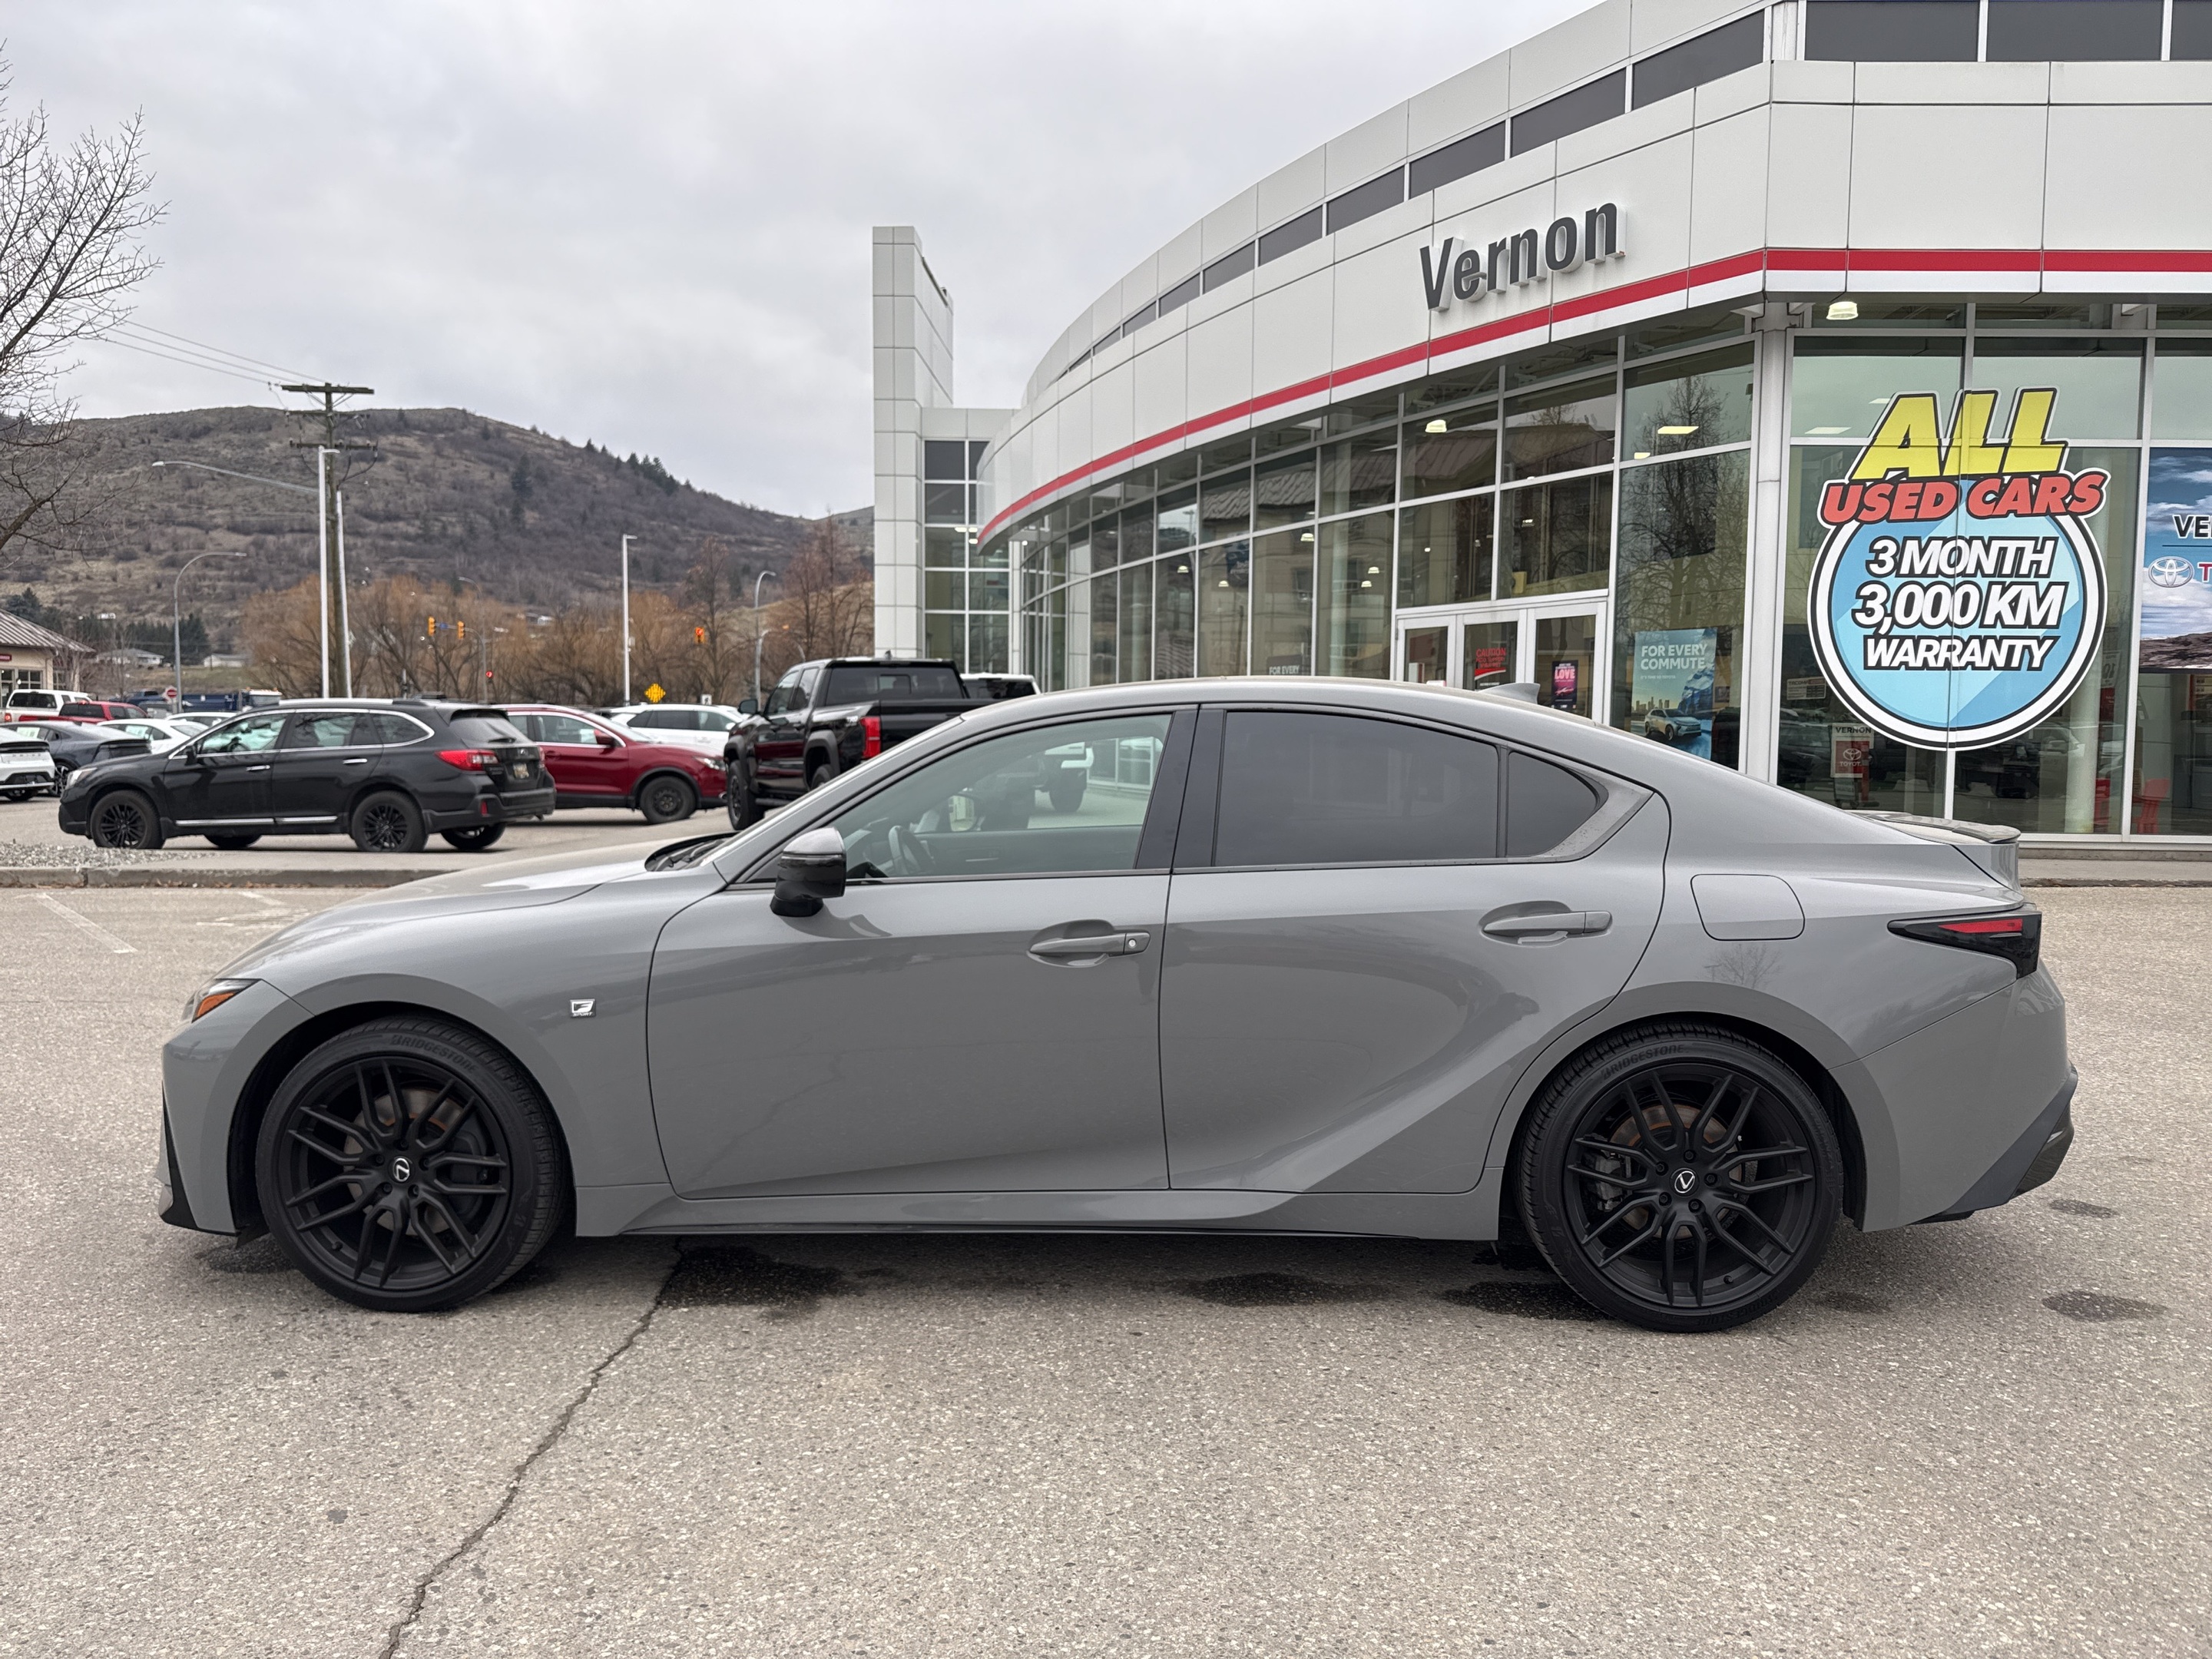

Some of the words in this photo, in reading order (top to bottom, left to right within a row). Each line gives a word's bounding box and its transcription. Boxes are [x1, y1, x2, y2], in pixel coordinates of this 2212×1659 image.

[1419, 203, 1622, 311] Vernon
[1850, 389, 2068, 480] ALL
[1823, 481, 1959, 523] USED
[1967, 473, 2107, 517] CARS
[2174, 515, 2212, 538] VE
[1869, 539, 1899, 575] 3
[1900, 539, 2055, 575] MONTH
[1856, 584, 1980, 635] 3,000
[1984, 585, 2065, 626] KM
[1641, 645, 1665, 657] FOR
[1667, 644, 1707, 656] EVERY
[1641, 657, 1705, 670] COMMUTE
[1866, 638, 2055, 667] WARRANTY
[1269, 666, 1280, 675] FOR
[1282, 664, 1300, 674] EVERY
[1555, 669, 1575, 680] LOVE
[390, 1034, 478, 1072] BRIDGESTONE
[1602, 1044, 1684, 1079] BRIDGESTONE
